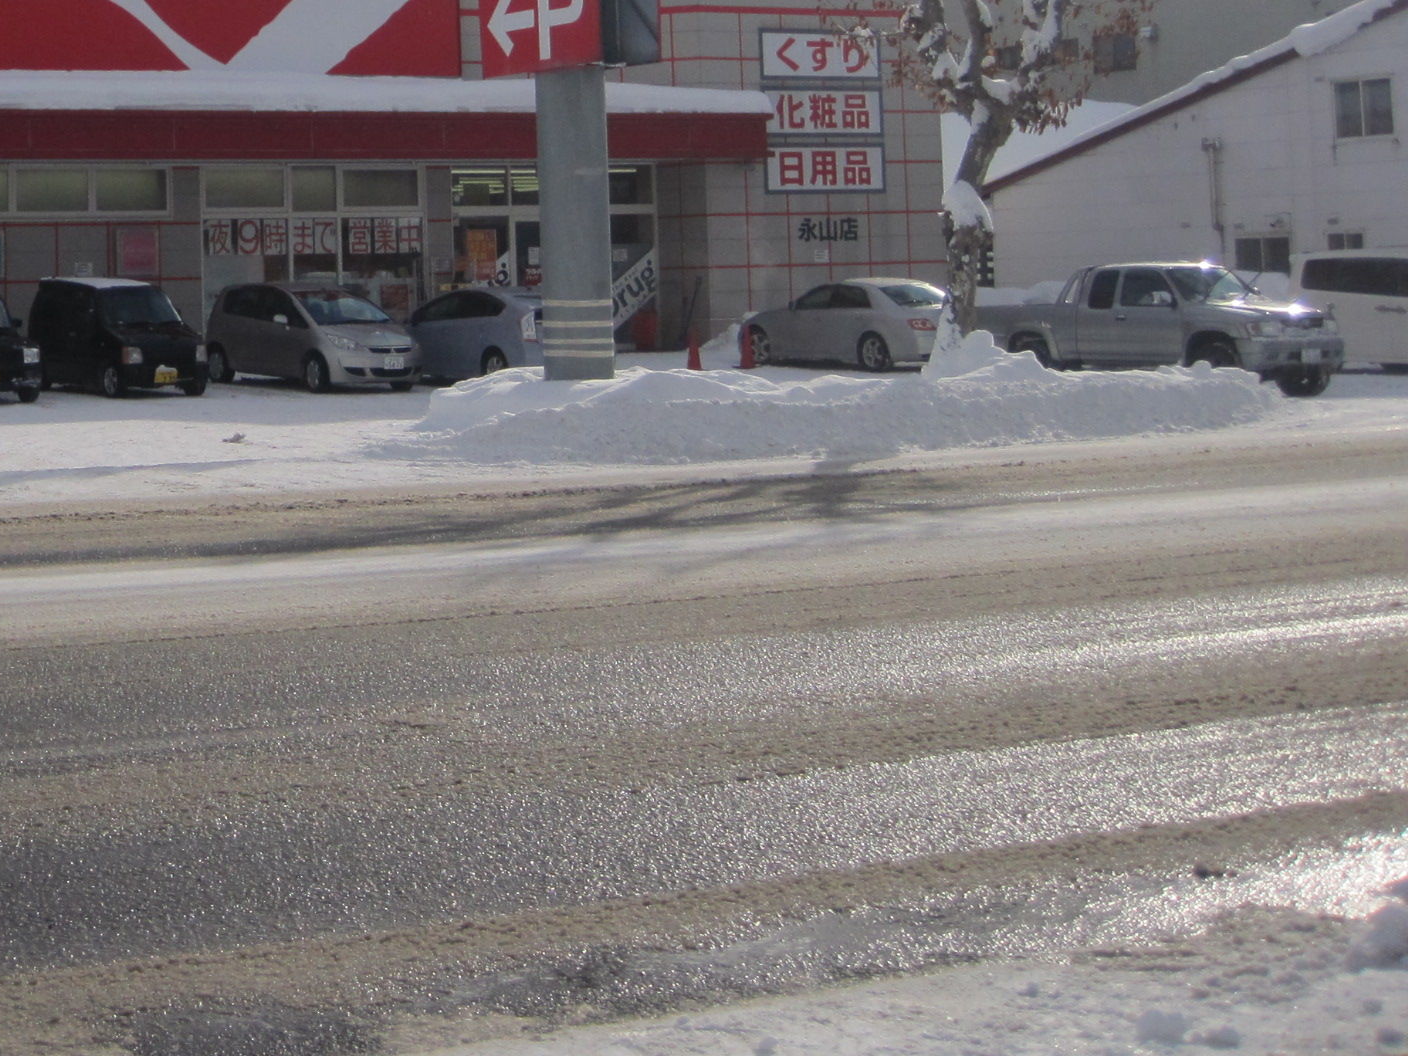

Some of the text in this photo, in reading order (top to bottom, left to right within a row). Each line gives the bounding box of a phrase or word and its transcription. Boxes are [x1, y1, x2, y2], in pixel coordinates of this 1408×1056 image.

[776, 36, 868, 74] くすり
[776, 94, 870, 129] 化粧品
[779, 150, 872, 186] 日用品
[798, 217, 859, 242] 永山店
